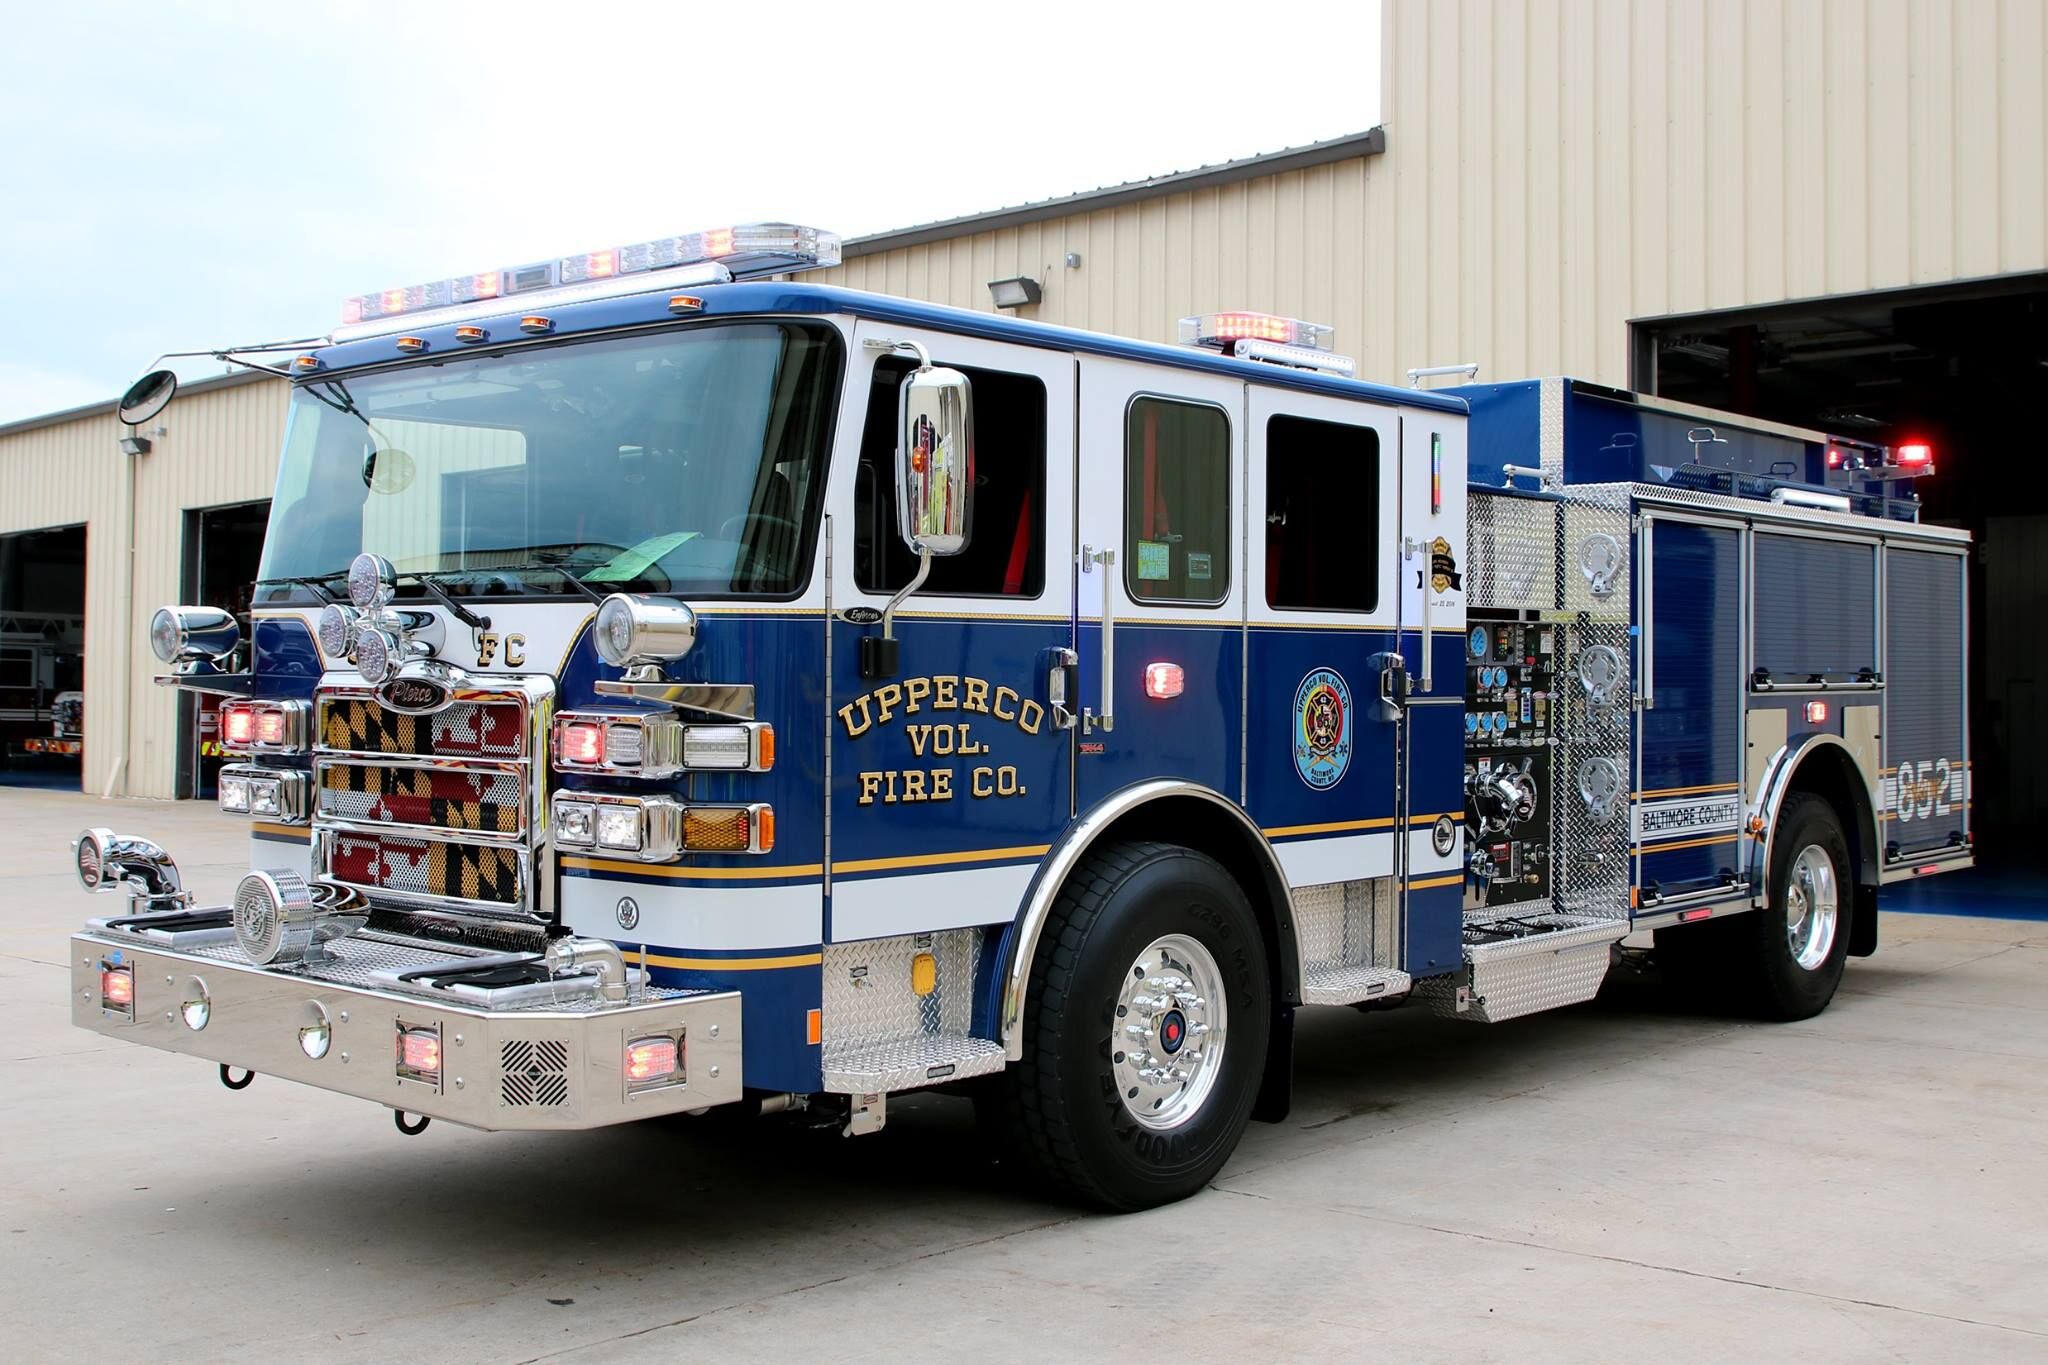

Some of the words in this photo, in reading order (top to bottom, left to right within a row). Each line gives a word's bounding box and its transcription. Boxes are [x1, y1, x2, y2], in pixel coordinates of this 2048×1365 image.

[389, 681, 433, 704] Pierce
[837, 675, 1045, 737] UPPERCO
[1297, 677, 1317, 713] UPPERCO
[1331, 677, 1343, 696] FIRE
[906, 723, 990, 756] VOL.
[858, 767, 953, 804] FIRE
[972, 764, 1027, 797] CO.
[1898, 757, 1950, 822] 852
[1642, 808, 1695, 830] BALTIMORE
[1699, 803, 1735, 823] COUNTY
